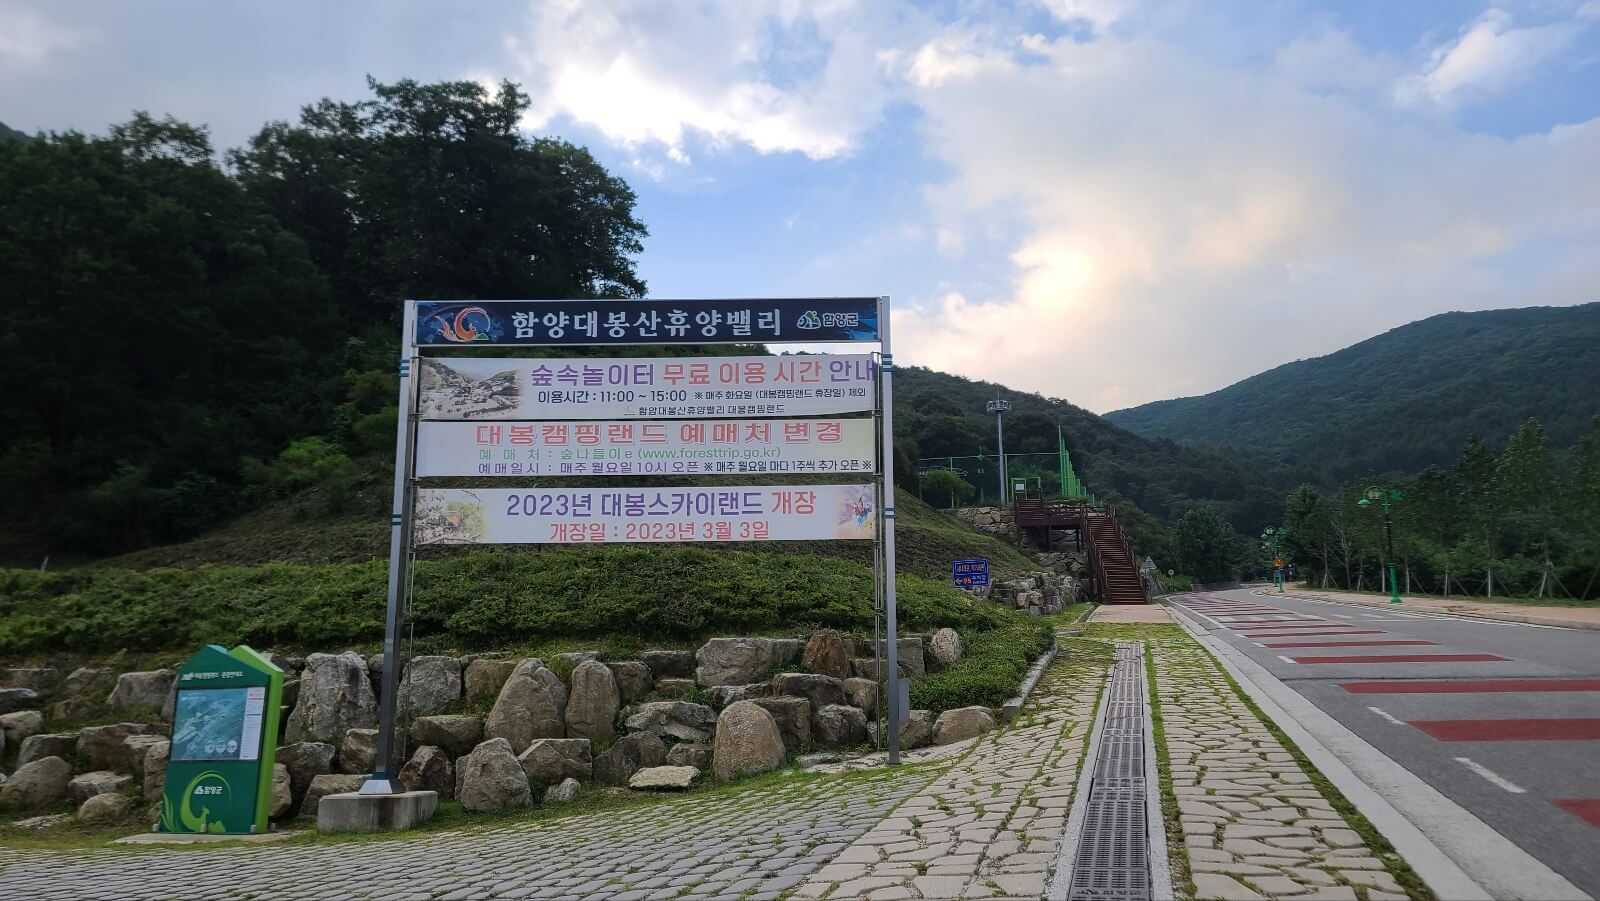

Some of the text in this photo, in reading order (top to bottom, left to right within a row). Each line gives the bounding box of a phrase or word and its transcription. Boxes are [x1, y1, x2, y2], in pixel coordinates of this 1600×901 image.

[511, 309, 781, 339] 함양대봉산휴양밸리
[823, 313, 858, 327] 함양군
[531, 364, 654, 387] 숲속놀이터
[663, 363, 711, 386] 무료
[719, 362, 766, 385] 이용
[774, 361, 822, 384] 시간
[538, 390, 589, 404] 이용시간
[600, 391, 634, 402] 11:00
[650, 390, 687, 402] 15:00
[706, 391, 724, 400] 매주
[848, 387, 866, 398] 제외
[638, 404, 785, 417] 함양대봉산휴양밸리 대봉캠핑랜드
[476, 421, 843, 446] 대봉캠핑랜드 예매처 변경
[637, 447, 781, 459] (www.foresttrip.go.kr)
[478, 462, 539, 475] 예매일시
[560, 462, 587, 474] 매주
[591, 462, 632, 474] 월요일
[637, 462, 667, 474] 10시
[672, 461, 699, 473] 오픈
[716, 461, 736, 472] 매주
[738, 461, 767, 472] 월요일
[769, 460, 789, 472] 마다
[818, 460, 837, 472] 추가
[840, 459, 859, 471] 오픈
[506, 490, 817, 518] 2023년 대봉스카이랜드 개장
[550, 522, 606, 542] 개장일
[626, 521, 695, 541] 2023년
[702, 521, 732, 540] 3월
[740, 520, 769, 540] 3일
